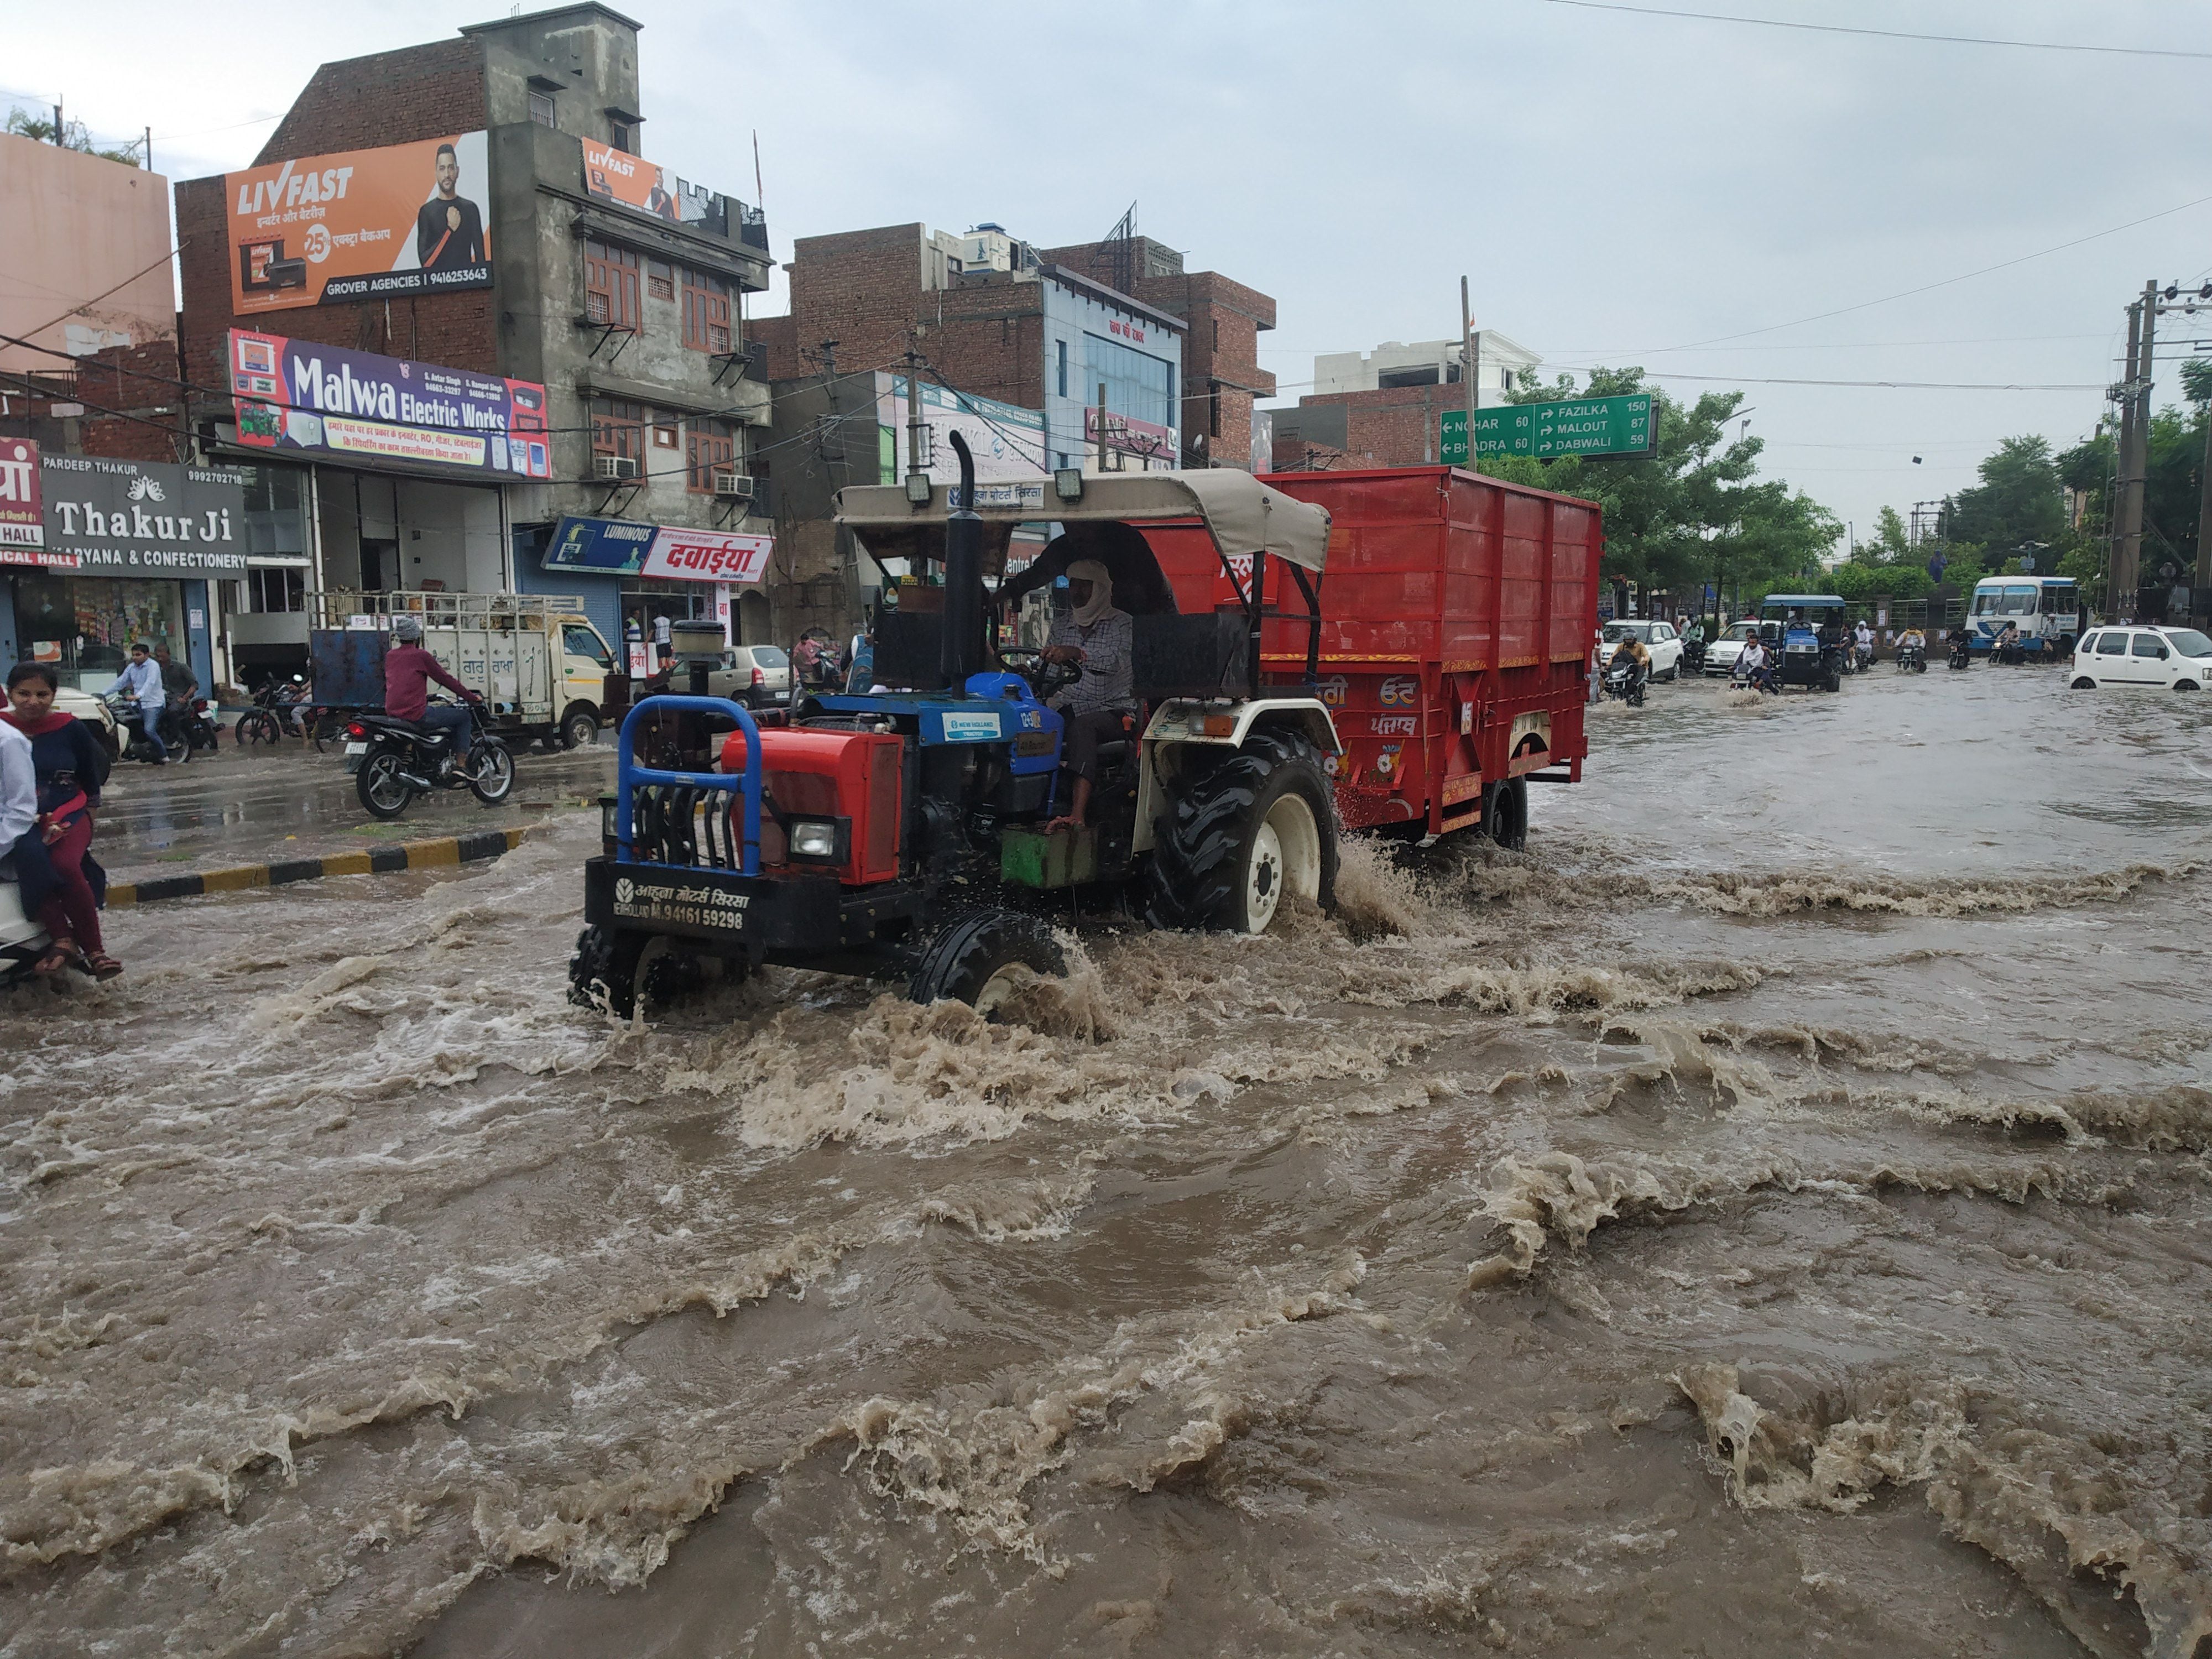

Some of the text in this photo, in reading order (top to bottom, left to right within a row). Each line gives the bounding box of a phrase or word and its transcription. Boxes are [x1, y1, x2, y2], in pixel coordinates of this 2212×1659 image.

[588, 147, 635, 177] LIVFAST
[237, 160, 353, 215] LIVFAST
[257, 213, 280, 229] इन्वर्टर
[283, 209, 298, 223] और
[333, 228, 390, 248] एक्स्ट्रा बैकअप
[327, 268, 487, 295] GROVER AGENCIES 9416253643
[425, 372, 461, 386] S. Avtar Singh
[490, 383, 503, 393] Singh
[293, 355, 397, 420] Malwa
[401, 393, 458, 427] Electric
[461, 401, 504, 436] Works
[1558, 401, 1646, 418] FAZILKA 150
[1516, 416, 1528, 427] 60
[1557, 418, 1645, 434] MALOUT 87
[1515, 438, 1528, 449] 60
[1556, 435, 1644, 450] DABWALI 59
[43, 457, 138, 476] PARDEEP THAKUR
[189, 471, 242, 485] 9992702718
[990, 487, 1011, 500] मोटर्स
[1015, 486, 1042, 499] सिरसा
[55, 501, 232, 542] Thakur Ji
[3, 527, 38, 543] HALL
[603, 524, 651, 542] LUMINOUS
[38, 553, 74, 566] HALL
[129, 550, 139, 565] &
[144, 551, 246, 569] CONFECTIONERY
[666, 540, 761, 575] दवाईयां
[1371, 714, 1417, 735] ਪੰਜਾਬ
[676, 885, 710, 904] मोटर्स
[711, 889, 750, 909] सिरसा
